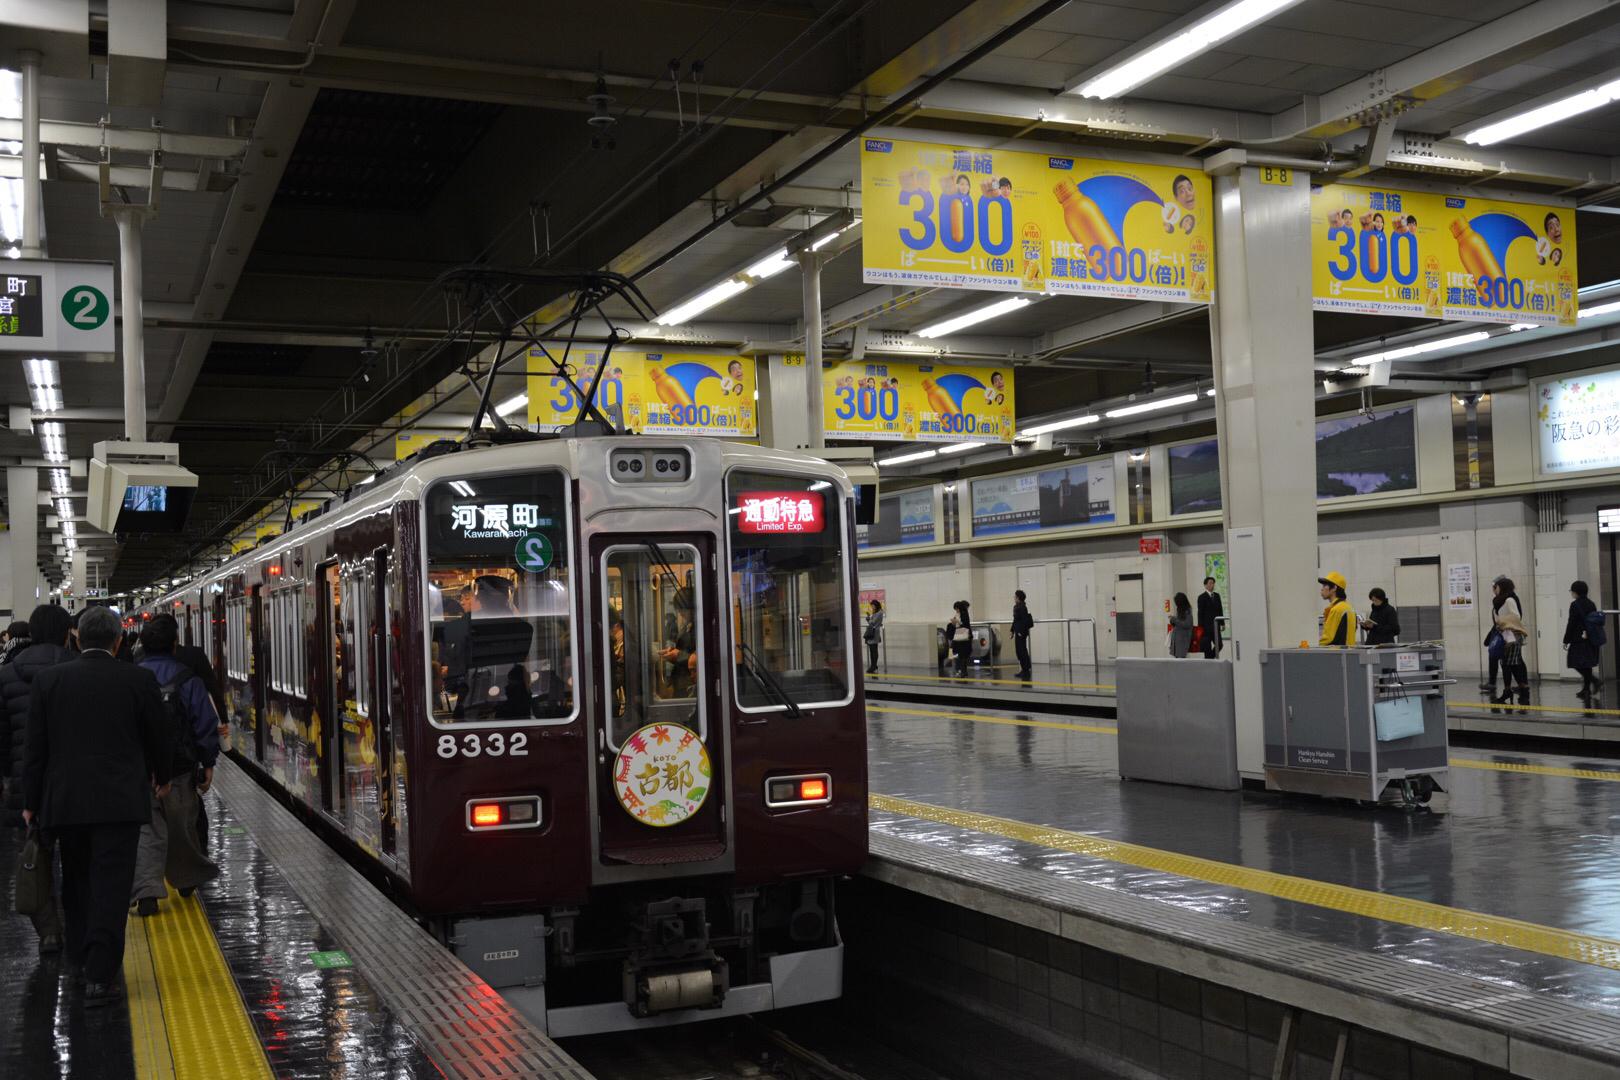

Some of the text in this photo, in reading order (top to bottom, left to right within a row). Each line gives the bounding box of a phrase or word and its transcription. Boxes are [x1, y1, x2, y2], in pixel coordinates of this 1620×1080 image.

[953, 151, 993, 174] 濃縮
[1265, 167, 1287, 183] B-8
[1370, 192, 1402, 212] 濃縮
[899, 188, 1013, 256] 300
[1050, 257, 1087, 279] 濃縮
[1088, 245, 1147, 284] 300
[1328, 226, 1418, 285] 300
[7, 277, 27, 296] 町
[1446, 287, 1477, 306] 濃縮
[1478, 275, 1524, 309] 300
[73, 291, 98, 323] 2
[786, 355, 801, 365] B-9
[672, 404, 711, 426] 300
[835, 386, 898, 421] 300
[941, 413, 976, 433] 300
[451, 503, 539, 530] 河原町
[743, 496, 815, 522] 通勤特急
[756, 522, 804, 531] Limited Exp.
[437, 732, 529, 759] 8332
[635, 759, 694, 797] 古都
